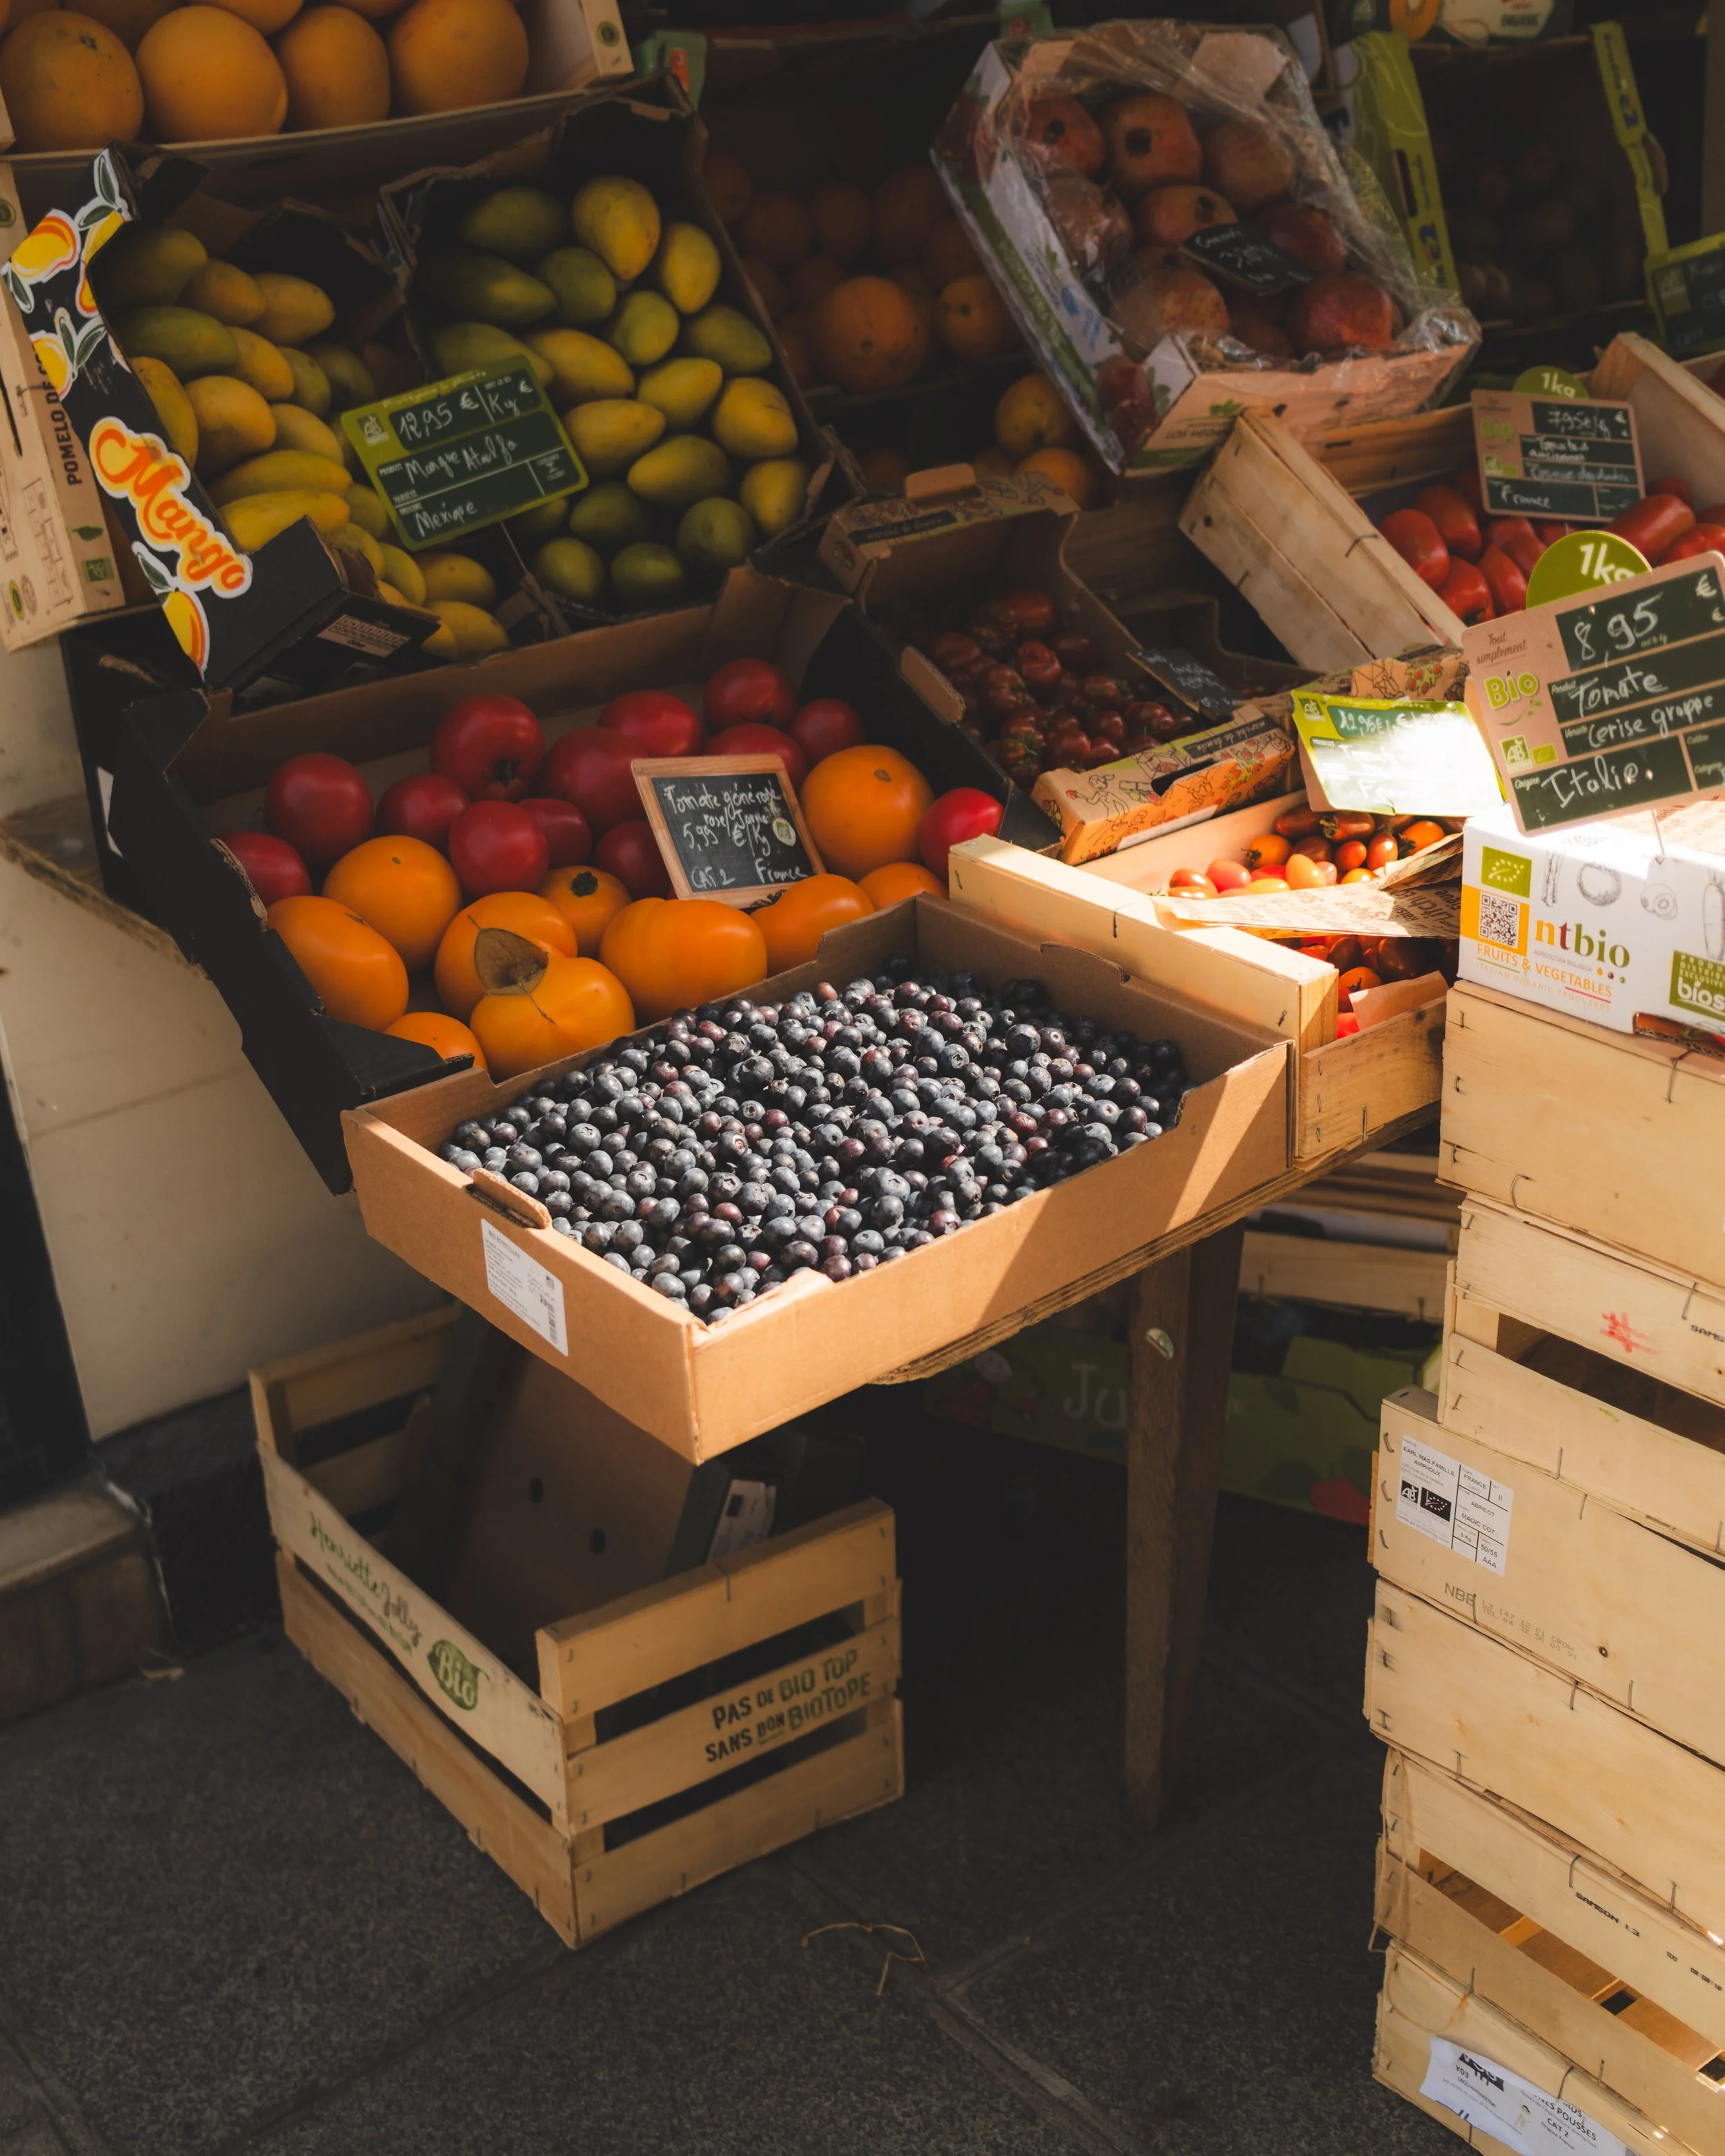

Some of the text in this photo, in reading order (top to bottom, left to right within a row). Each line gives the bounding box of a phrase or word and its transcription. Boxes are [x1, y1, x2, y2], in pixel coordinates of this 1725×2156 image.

[400, 402, 453, 441] 12,95
[51, 409, 82, 486] POMELO
[404, 450, 461, 484] Mangue
[96, 428, 245, 590] Mango
[415, 502, 477, 537] Mexique
[1488, 631, 1508, 646] Tout
[1574, 592, 1664, 669] 8,95
[1476, 640, 1528, 664] simplement
[1483, 670, 1539, 711] Bio
[1570, 666, 1668, 718] Tomate
[1534, 918, 1631, 969] ntbio
[1477, 943, 1613, 998] FRUITS & VEGETABLES
[1403, 1445, 1455, 1476] EARL MAS FAMILLE
[1414, 1458, 1440, 1477] AMPHOUX
[1463, 1473, 1486, 1490] FRANCE
[1461, 1512, 1495, 1535] MAGIC COT
[1470, 1500, 1495, 1518] ABRICOT
[1464, 1534, 1471, 1543] Kg
[1480, 1543, 1497, 1558] 50/55
[1483, 1556, 1496, 1568] AAA
[436, 1644, 475, 1707] Bio
[712, 1649, 858, 1730] PAS DE BIO TOP
[705, 1672, 871, 1763] SANS BON BIOTOPE
[1575, 1892, 1639, 1937] SAMSON L3
[1455, 2064, 1469, 2079] Y03
[1546, 2117, 1569, 2139] CAT 2
[1557, 2107, 1597, 2142] POUSSES
